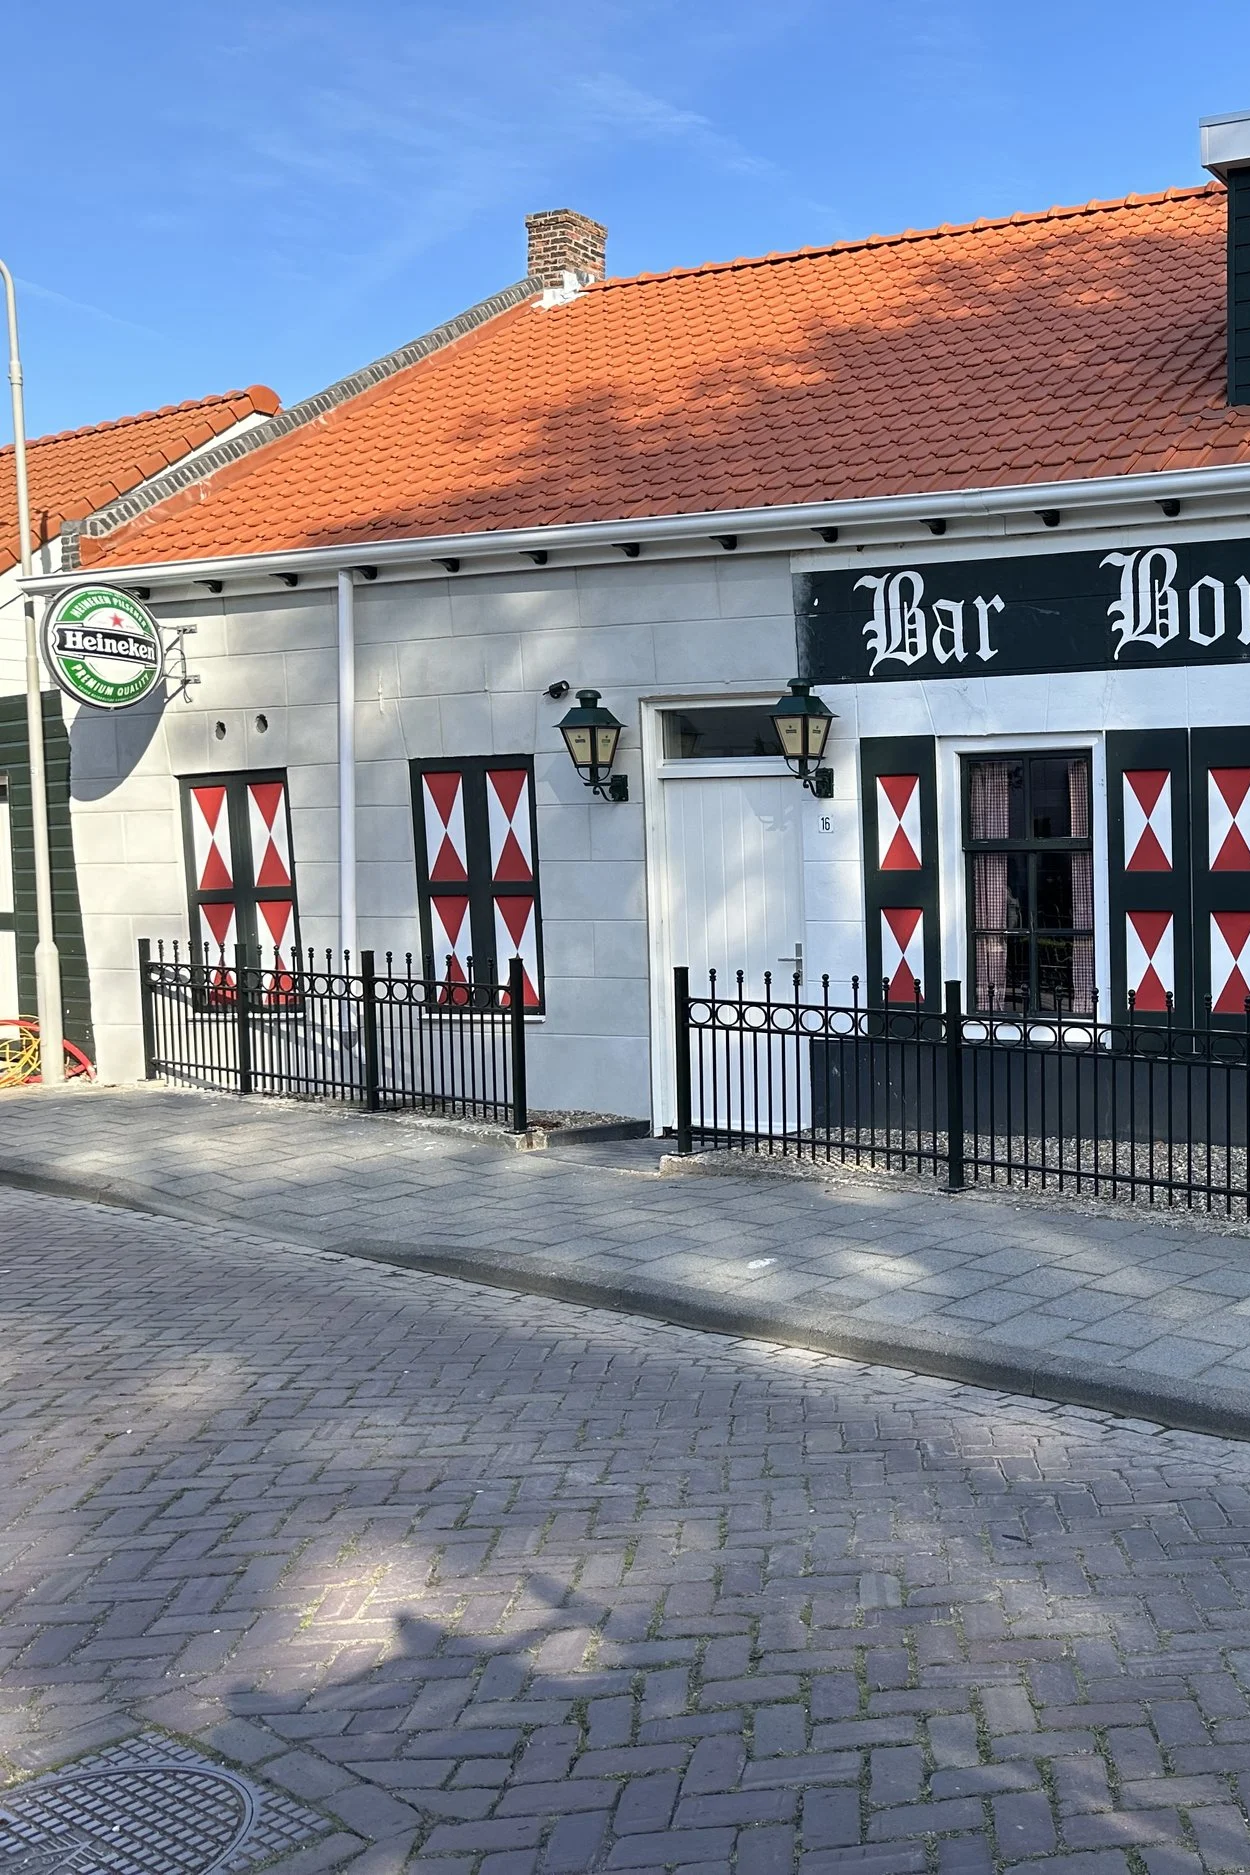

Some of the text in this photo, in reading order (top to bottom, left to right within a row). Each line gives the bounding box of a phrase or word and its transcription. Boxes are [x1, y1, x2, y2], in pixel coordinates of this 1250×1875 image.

[70, 595, 112, 618] HEINEKEN
[853, 570, 1006, 677] Bar
[64, 630, 156, 661] Heineken
[71, 663, 114, 696] PREMIUM
[117, 673, 149, 696] QUALITY
[821, 816, 831, 831] 16
